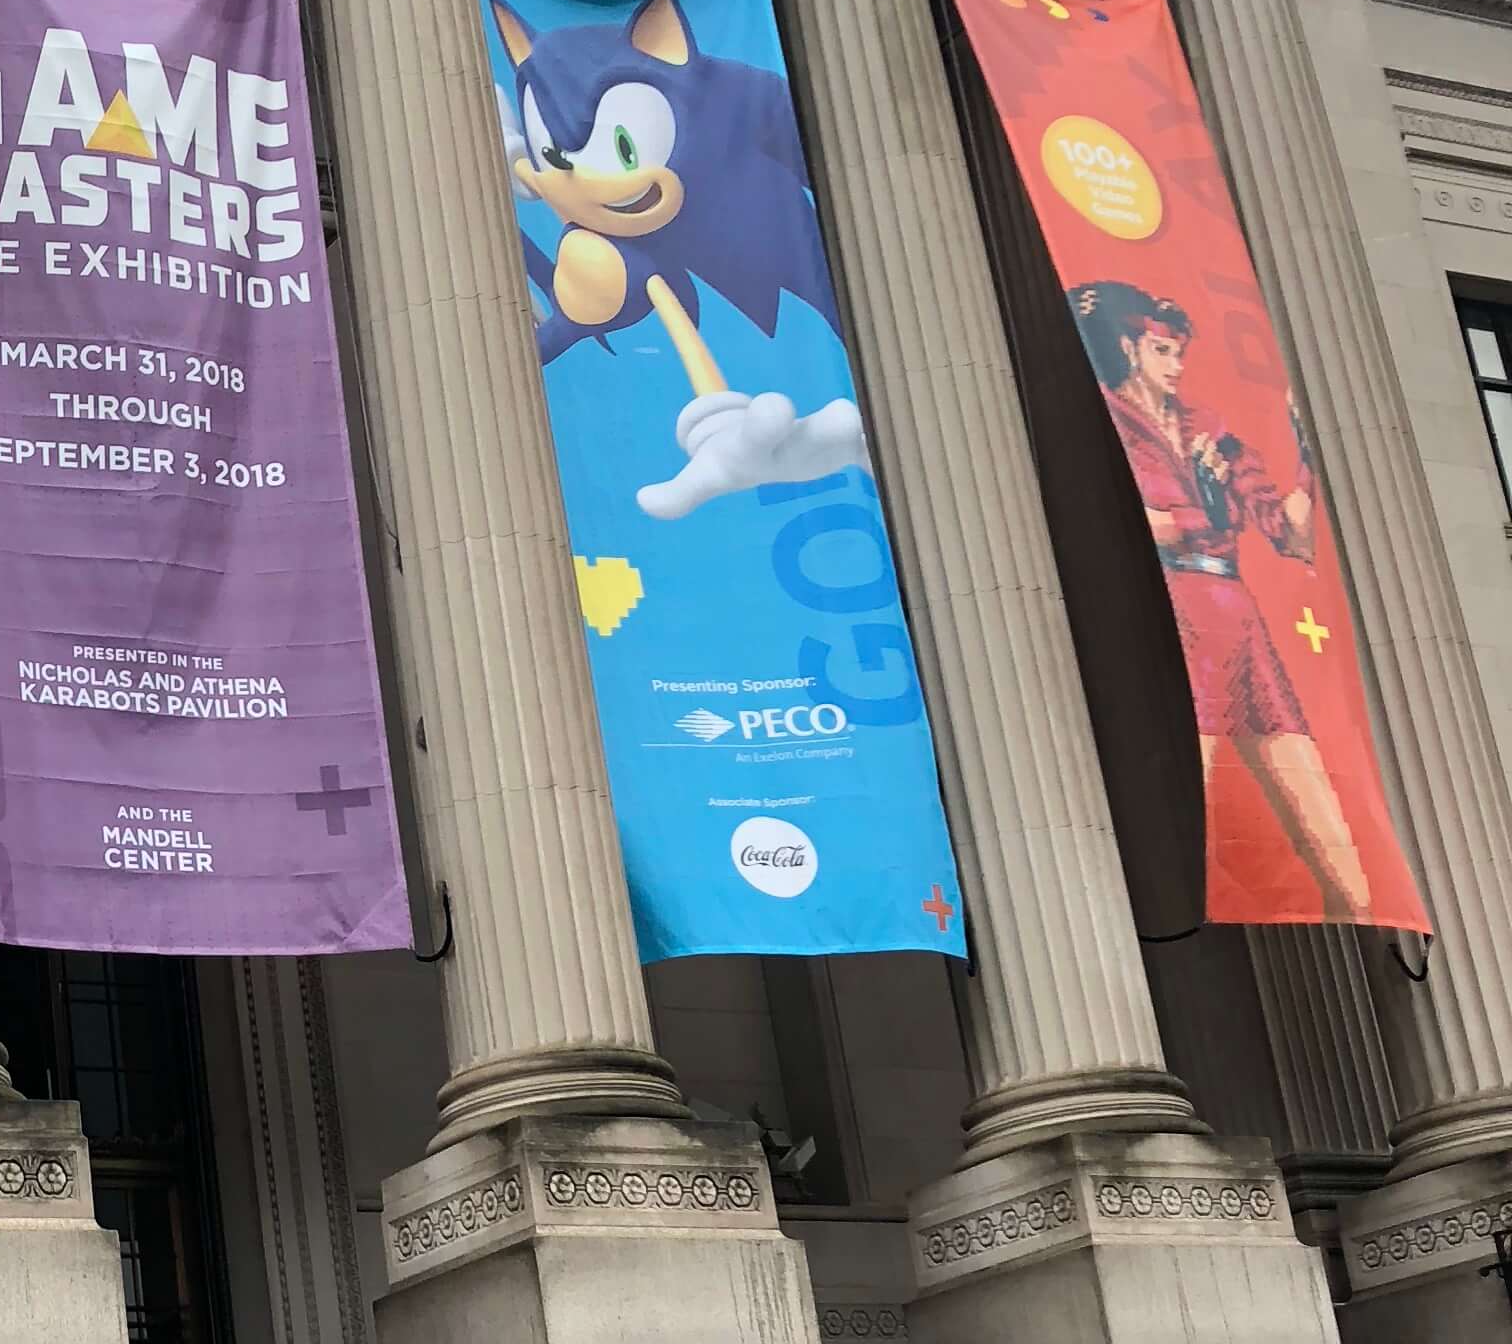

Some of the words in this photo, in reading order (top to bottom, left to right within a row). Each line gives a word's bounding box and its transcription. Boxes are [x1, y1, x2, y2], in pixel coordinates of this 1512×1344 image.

[46, 241, 311, 309] EXHIBITION
[0, 341, 126, 372] MARCH
[138, 349, 177, 383] 31,
[186, 357, 245, 393] 2018
[49, 393, 212, 432] THROUGH
[184, 452, 207, 485] 3,
[215, 460, 286, 488] 2018
[73, 645, 168, 665] PRESENTED
[172, 653, 187, 668] IN
[192, 656, 223, 670] THE
[19, 660, 133, 688] NICHOLAS
[139, 671, 185, 692] AND
[191, 677, 284, 695] ATHENA
[652, 679, 738, 694] Presenting
[742, 676, 816, 693] Sponsor:
[20, 681, 161, 714] KARABOTS
[167, 695, 288, 719] PAVILION
[738, 703, 847, 740] PECO
[795, 746, 854, 761] Company
[117, 805, 153, 820] AND
[159, 808, 193, 822] THE
[103, 825, 212, 849] MANDELL
[104, 847, 214, 872] CENTER
